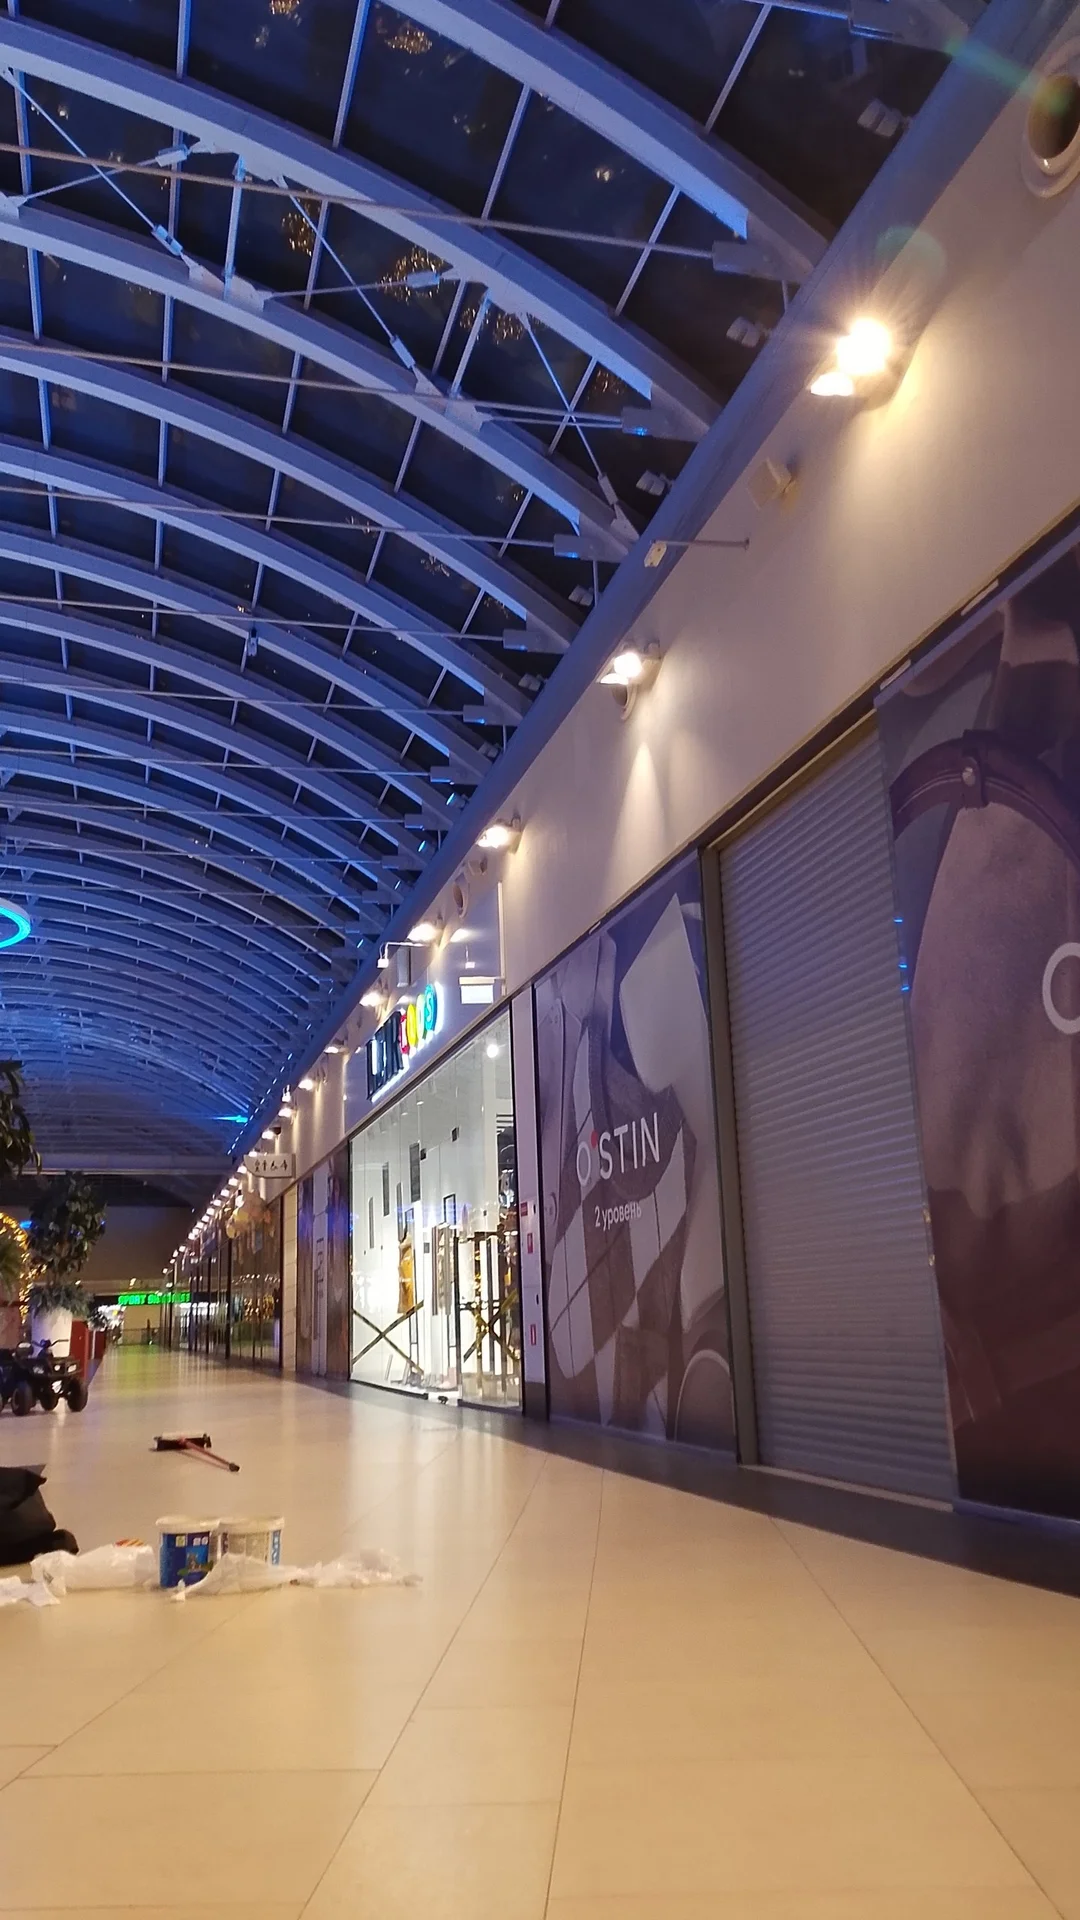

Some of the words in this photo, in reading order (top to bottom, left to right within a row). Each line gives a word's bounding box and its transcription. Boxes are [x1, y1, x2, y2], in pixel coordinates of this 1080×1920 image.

[576, 1112, 660, 1187] O'STIN
[594, 1205, 601, 1228] 2
[602, 1201, 642, 1231] уровень
